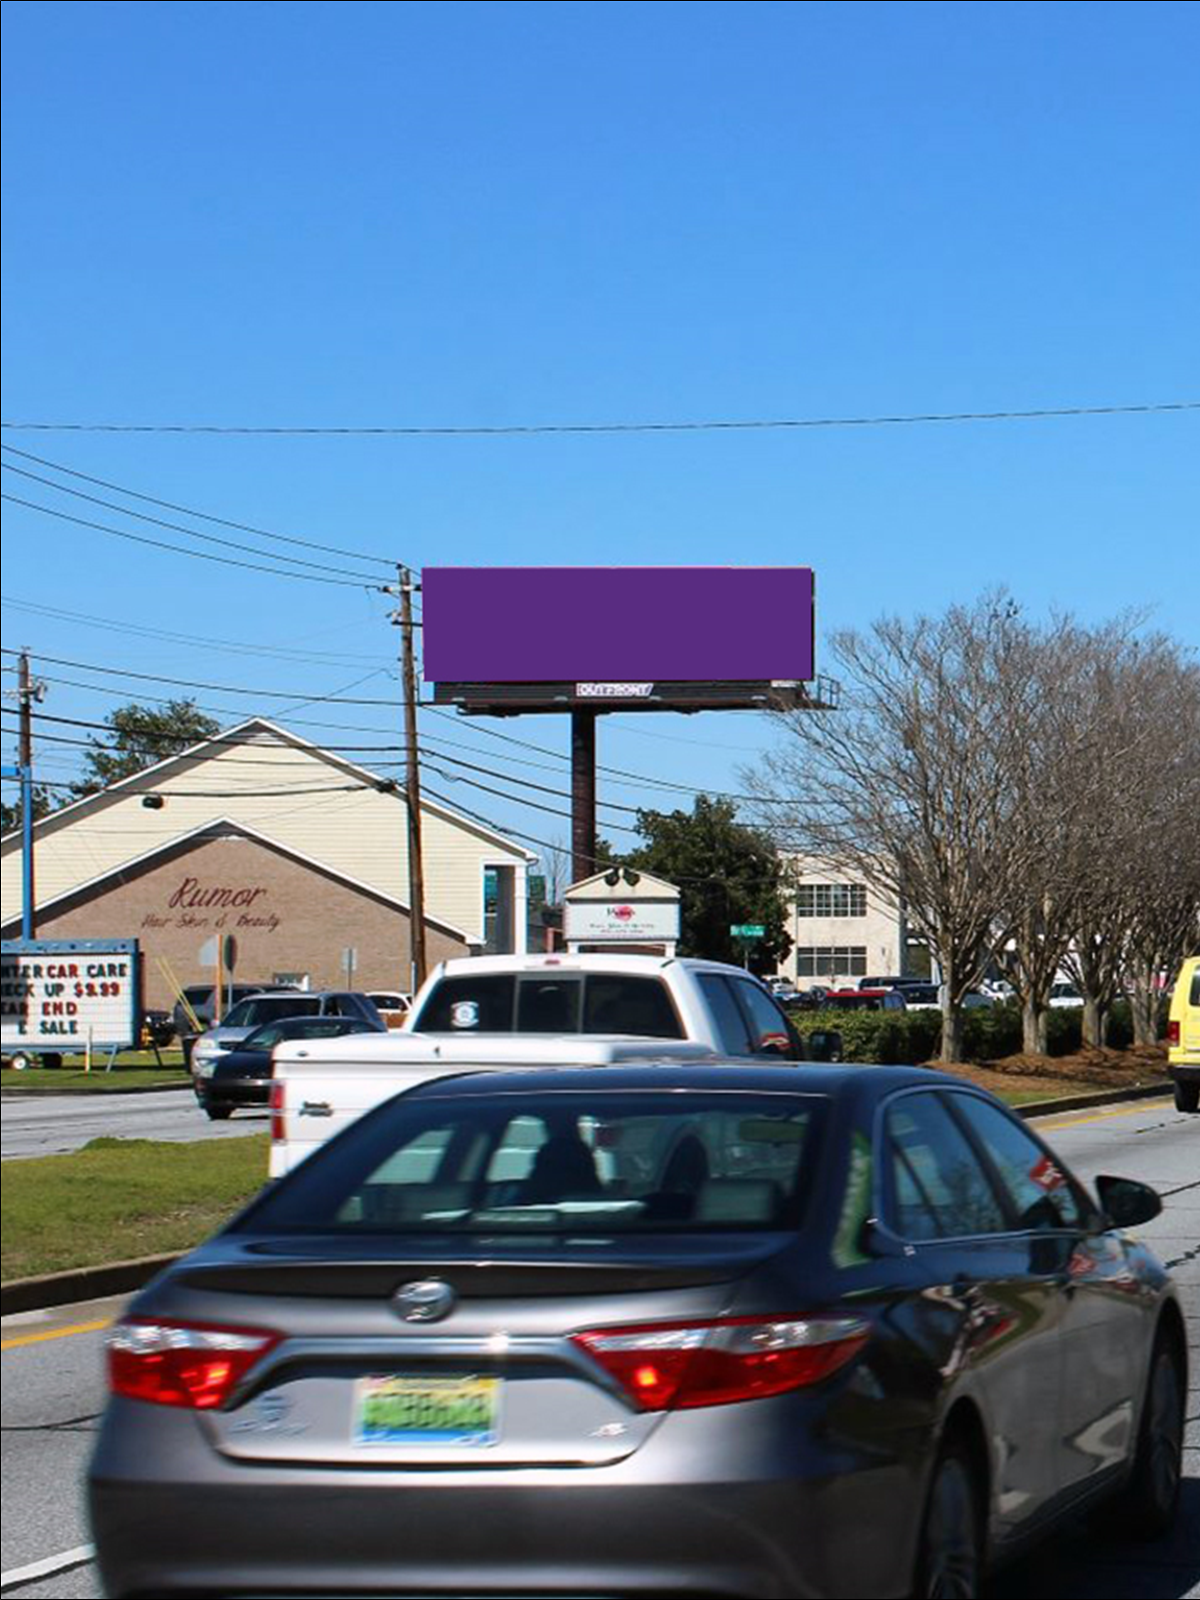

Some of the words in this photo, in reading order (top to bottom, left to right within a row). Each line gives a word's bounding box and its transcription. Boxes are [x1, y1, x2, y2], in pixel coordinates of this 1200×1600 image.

[169, 877, 267, 908] Rumor
[141, 913, 173, 928] Hair
[175, 912, 209, 928] Skin
[236, 912, 281, 932] Beauty
[47, 963, 79, 978] CAR
[86, 963, 127, 977] CARE
[1, 983, 35, 997] ECK
[44, 983, 65, 997] UP
[42, 1002, 78, 1016] END
[39, 1020, 78, 1034] SALE
